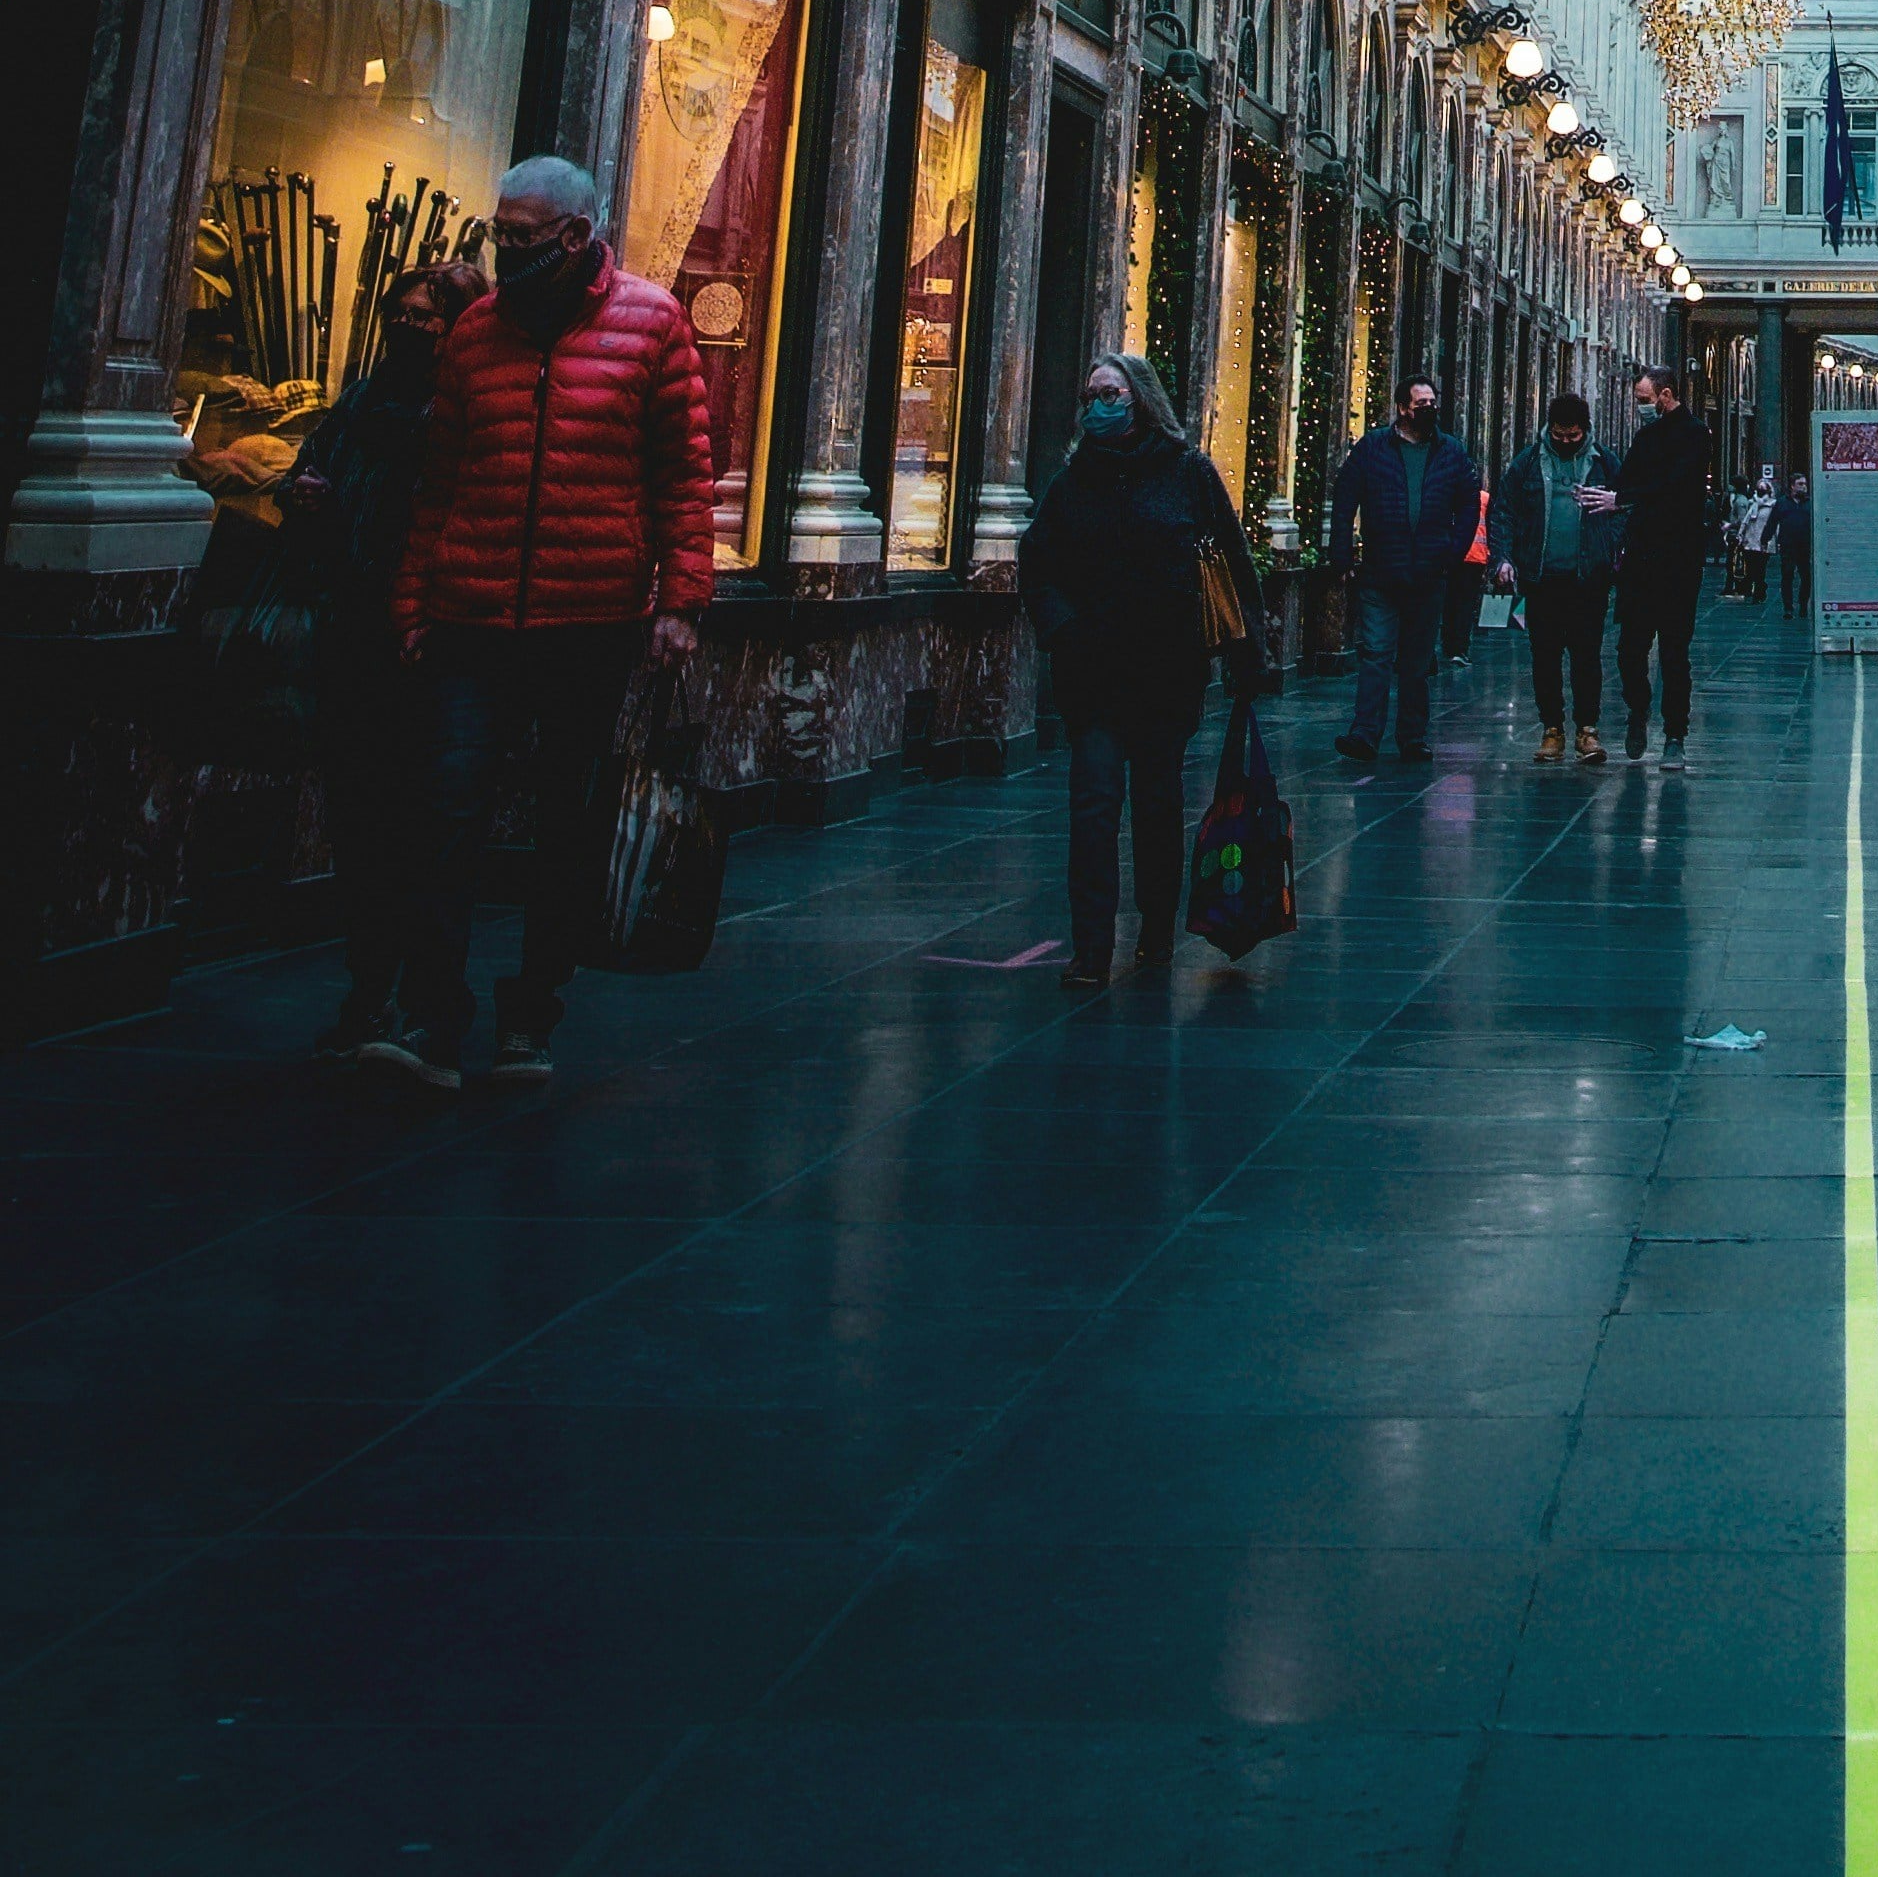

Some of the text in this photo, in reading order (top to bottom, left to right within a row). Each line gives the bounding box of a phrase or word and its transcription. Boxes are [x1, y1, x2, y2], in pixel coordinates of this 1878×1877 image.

[1784, 281, 1838, 292] GALERIE
[1840, 281, 1857, 292] DE
[1860, 281, 1876, 292] LA
